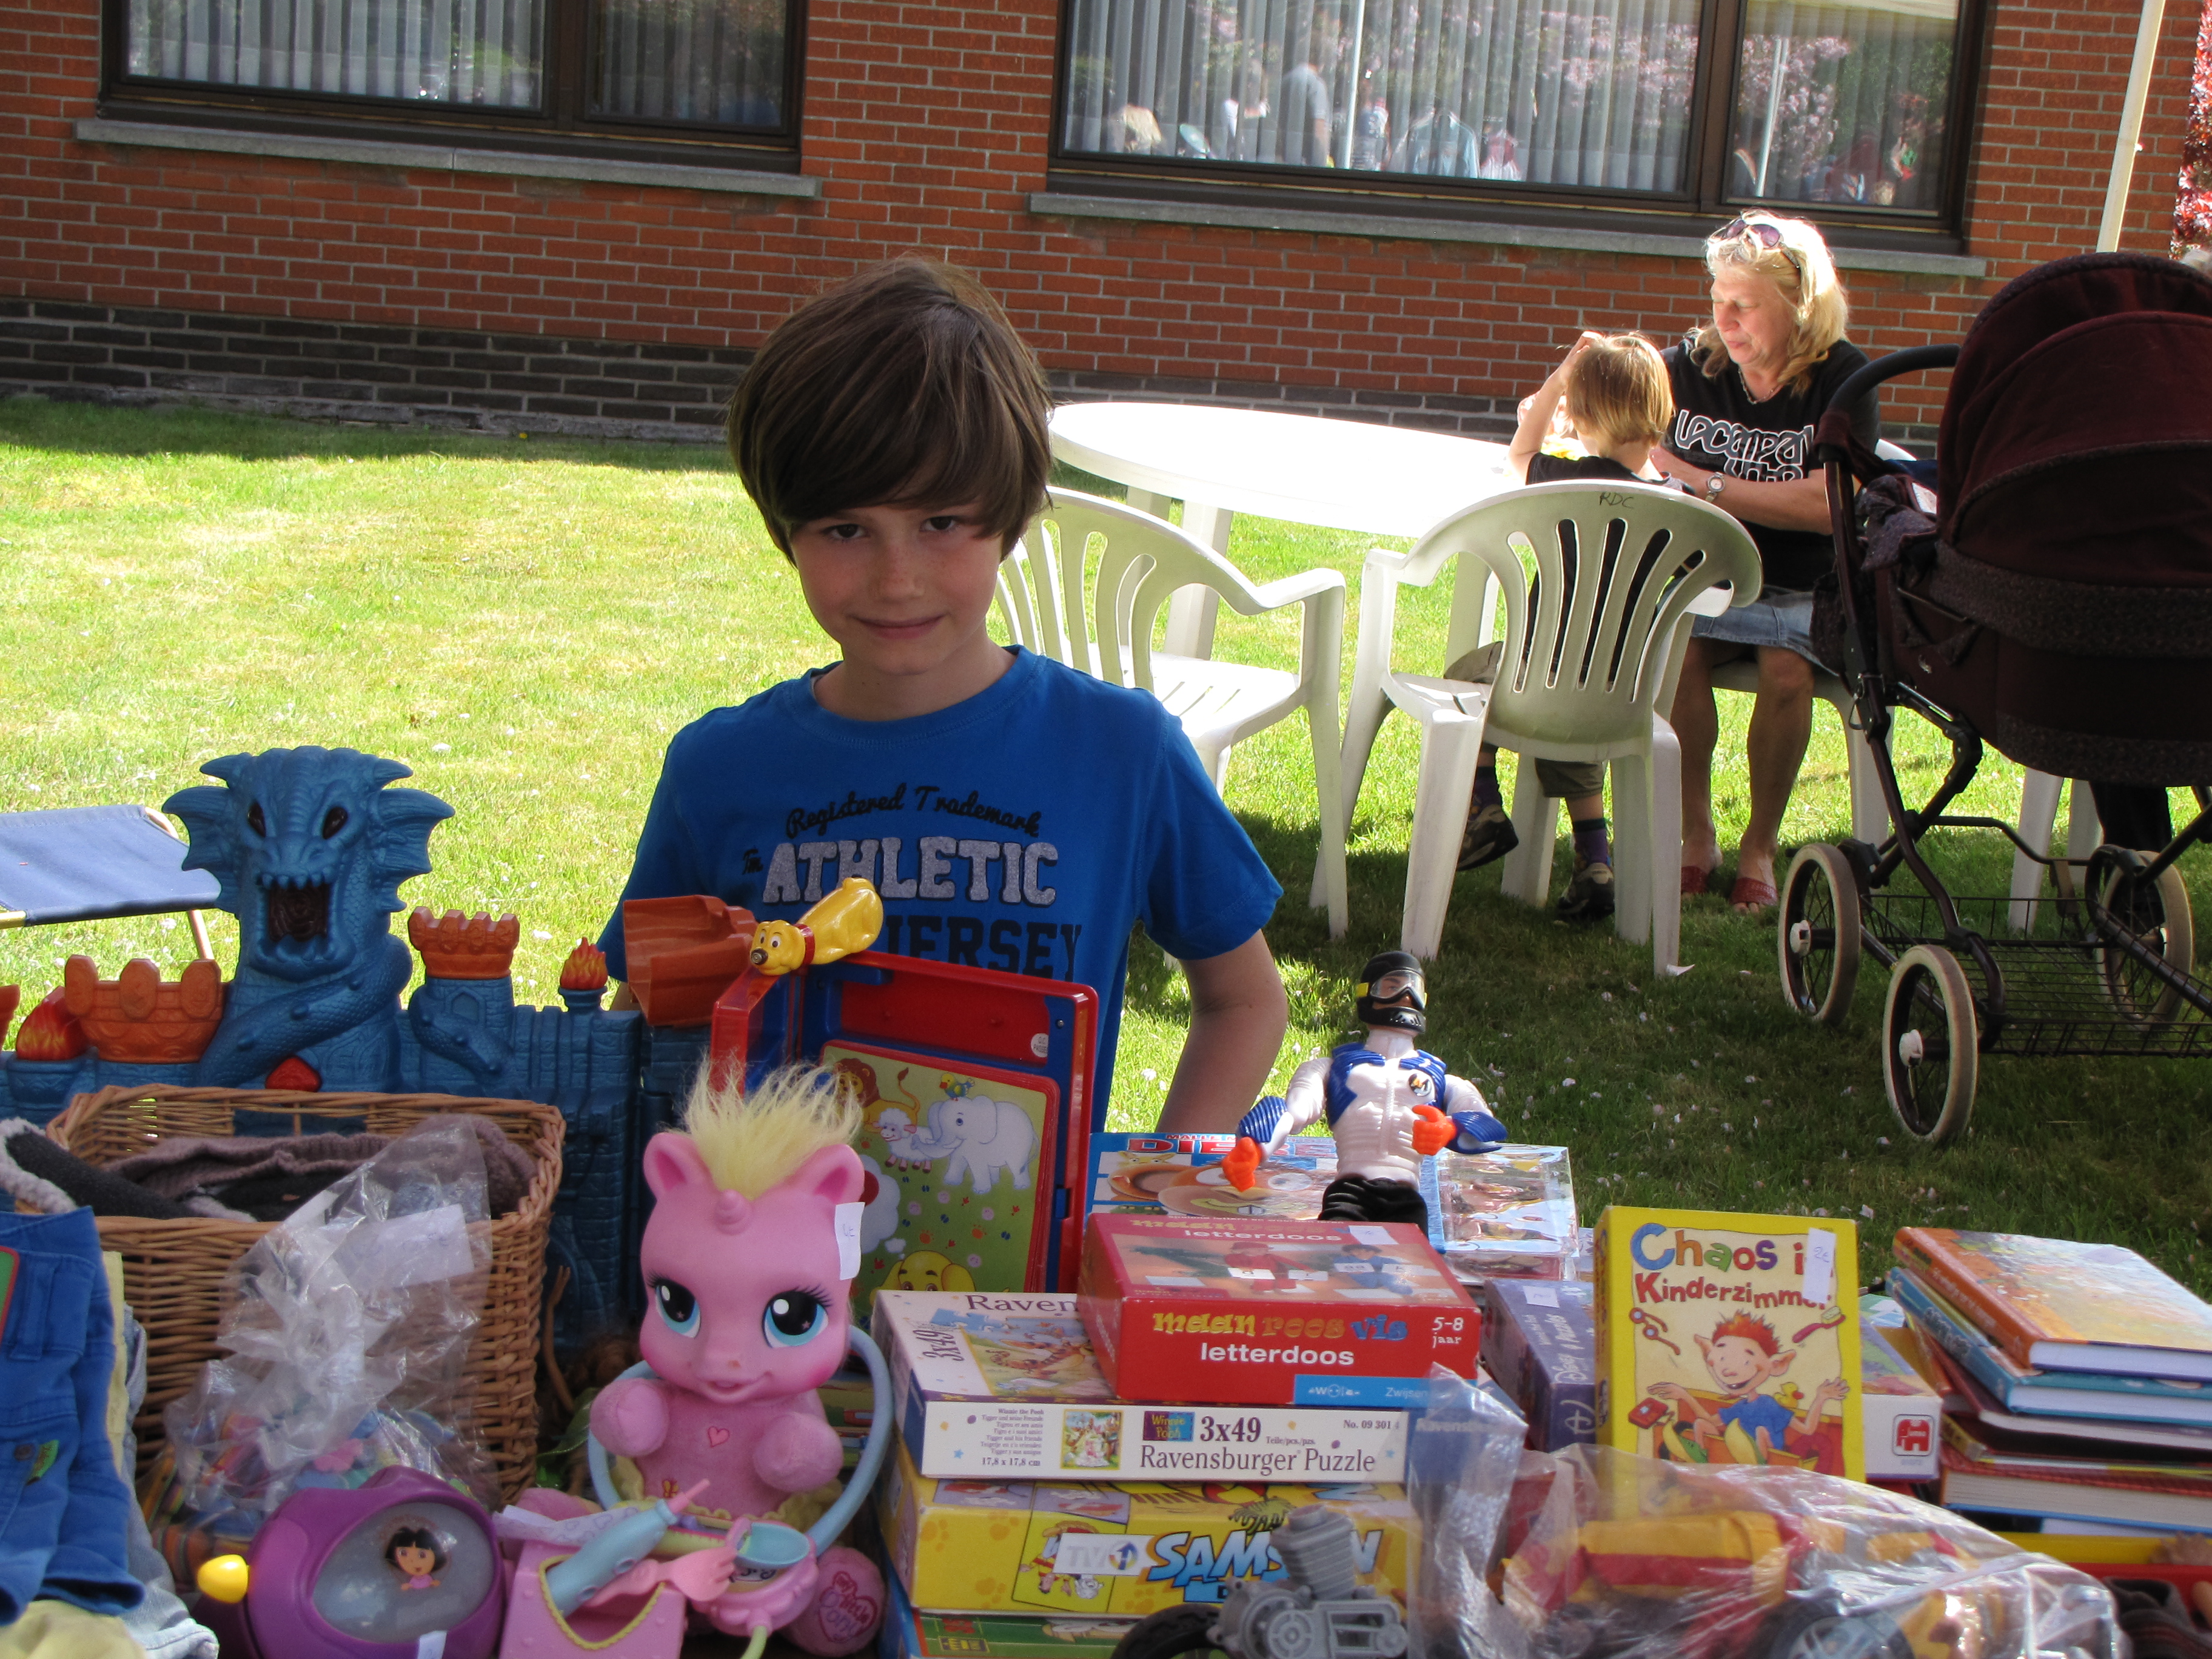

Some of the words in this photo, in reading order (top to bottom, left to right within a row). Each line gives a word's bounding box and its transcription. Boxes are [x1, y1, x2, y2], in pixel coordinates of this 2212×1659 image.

[1600, 492, 1635, 509] RDC
[786, 783, 908, 839] Registered
[915, 786, 1043, 838] Trademark
[762, 835, 1059, 907] ATHLETIC
[1184, 1230, 1342, 1241] letterdoos
[1630, 1222, 1778, 1272] Chaos
[1635, 1272, 1831, 1310] Kinderzimm
[1153, 1312, 1256, 1337] maan
[1262, 1316, 1346, 1339] roos
[1350, 1313, 1409, 1341] vis
[1432, 1316, 1464, 1332] 5-8
[1432, 1331, 1463, 1349] jaar
[1200, 1342, 1355, 1366] letterdoos
[1199, 1415, 1262, 1443] 3x49
[1343, 1419, 1358, 1429] No.
[1361, 1419, 1373, 1429] 09
[1375, 1420, 1392, 1430] 301
[982, 1457, 999, 1466] 17,8
[1010, 1458, 1026, 1466] 17,8
[1140, 1444, 1298, 1476] Ravensburger
[1305, 1447, 1376, 1472] Puzzle
